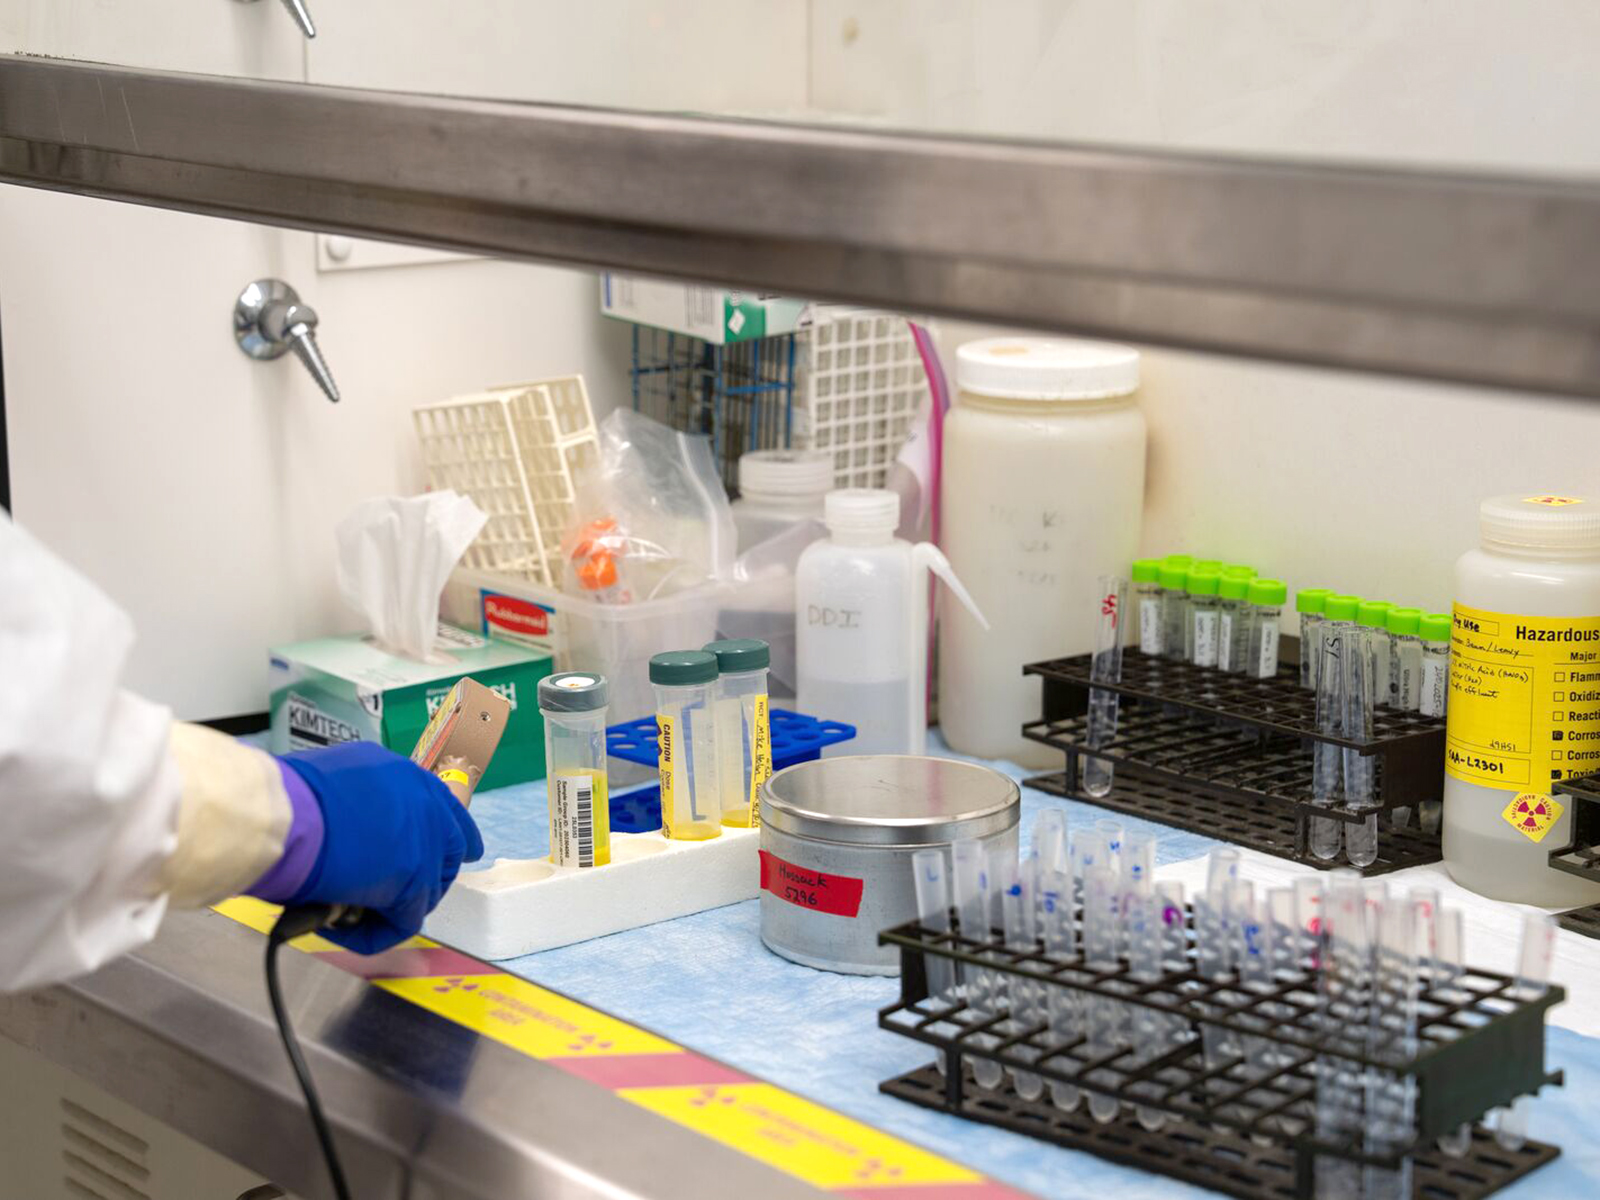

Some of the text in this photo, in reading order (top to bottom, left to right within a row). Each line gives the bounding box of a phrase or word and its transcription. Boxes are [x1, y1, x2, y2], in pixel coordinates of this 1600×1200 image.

[1516, 625, 1600, 642] Hazardous
[1570, 651, 1597, 662] Major
[289, 705, 360, 743] KIMTECH
[663, 724, 671, 763] CAUTION
[1517, 823, 1544, 833] MATERIAL
